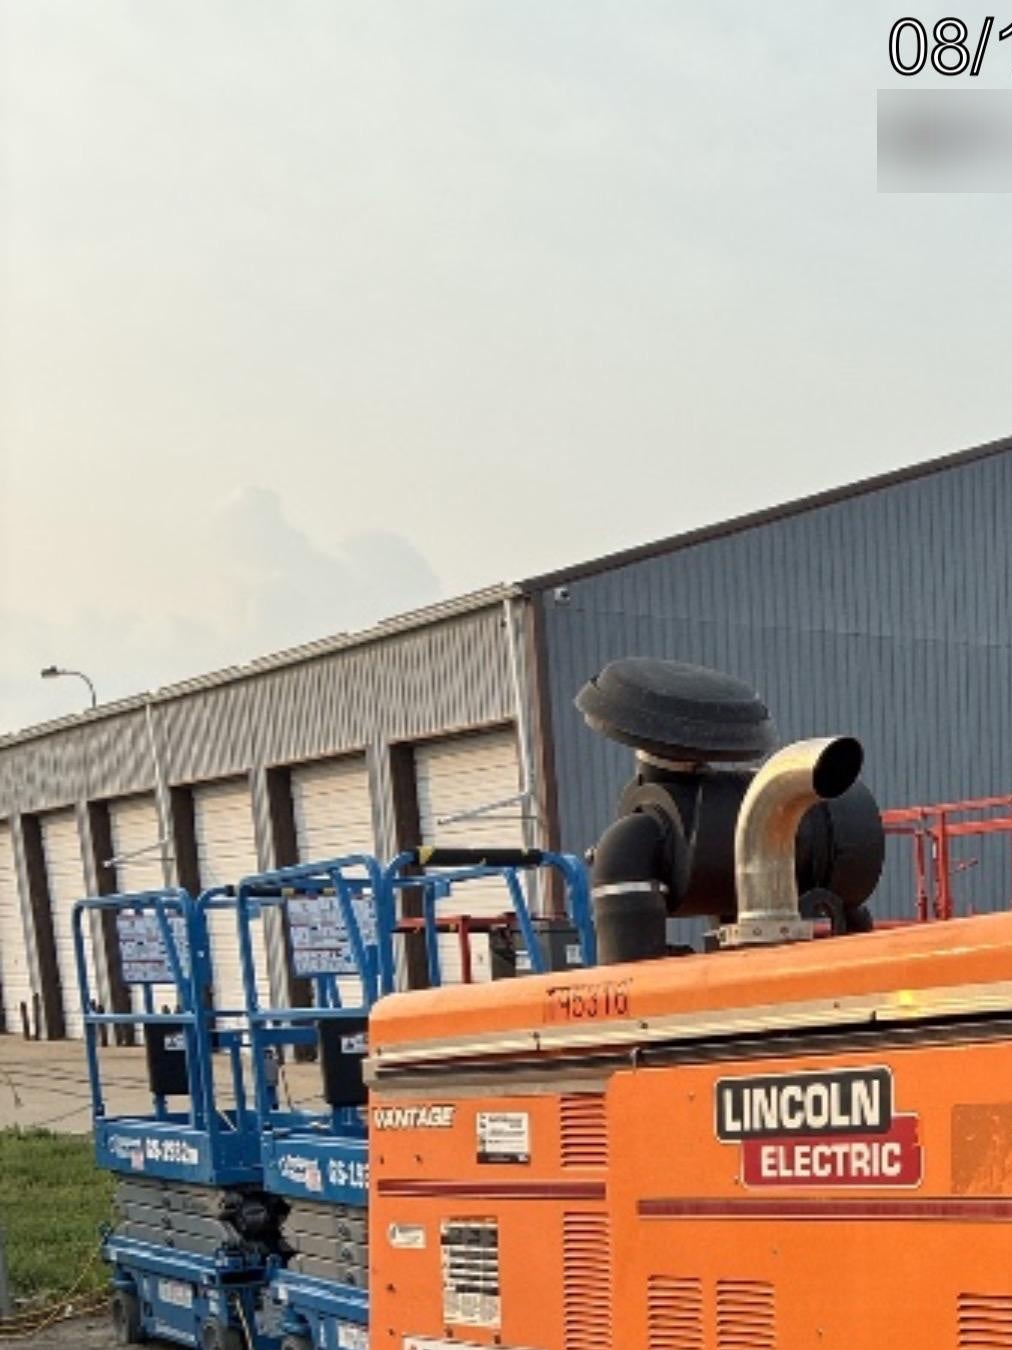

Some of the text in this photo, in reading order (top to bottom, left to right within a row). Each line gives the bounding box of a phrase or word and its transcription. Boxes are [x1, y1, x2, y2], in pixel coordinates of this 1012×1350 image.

[373, 1105, 455, 1130] VANTAGE
[723, 1079, 880, 1132] LINCOLN
[761, 1142, 901, 1178] ELECTRIC
